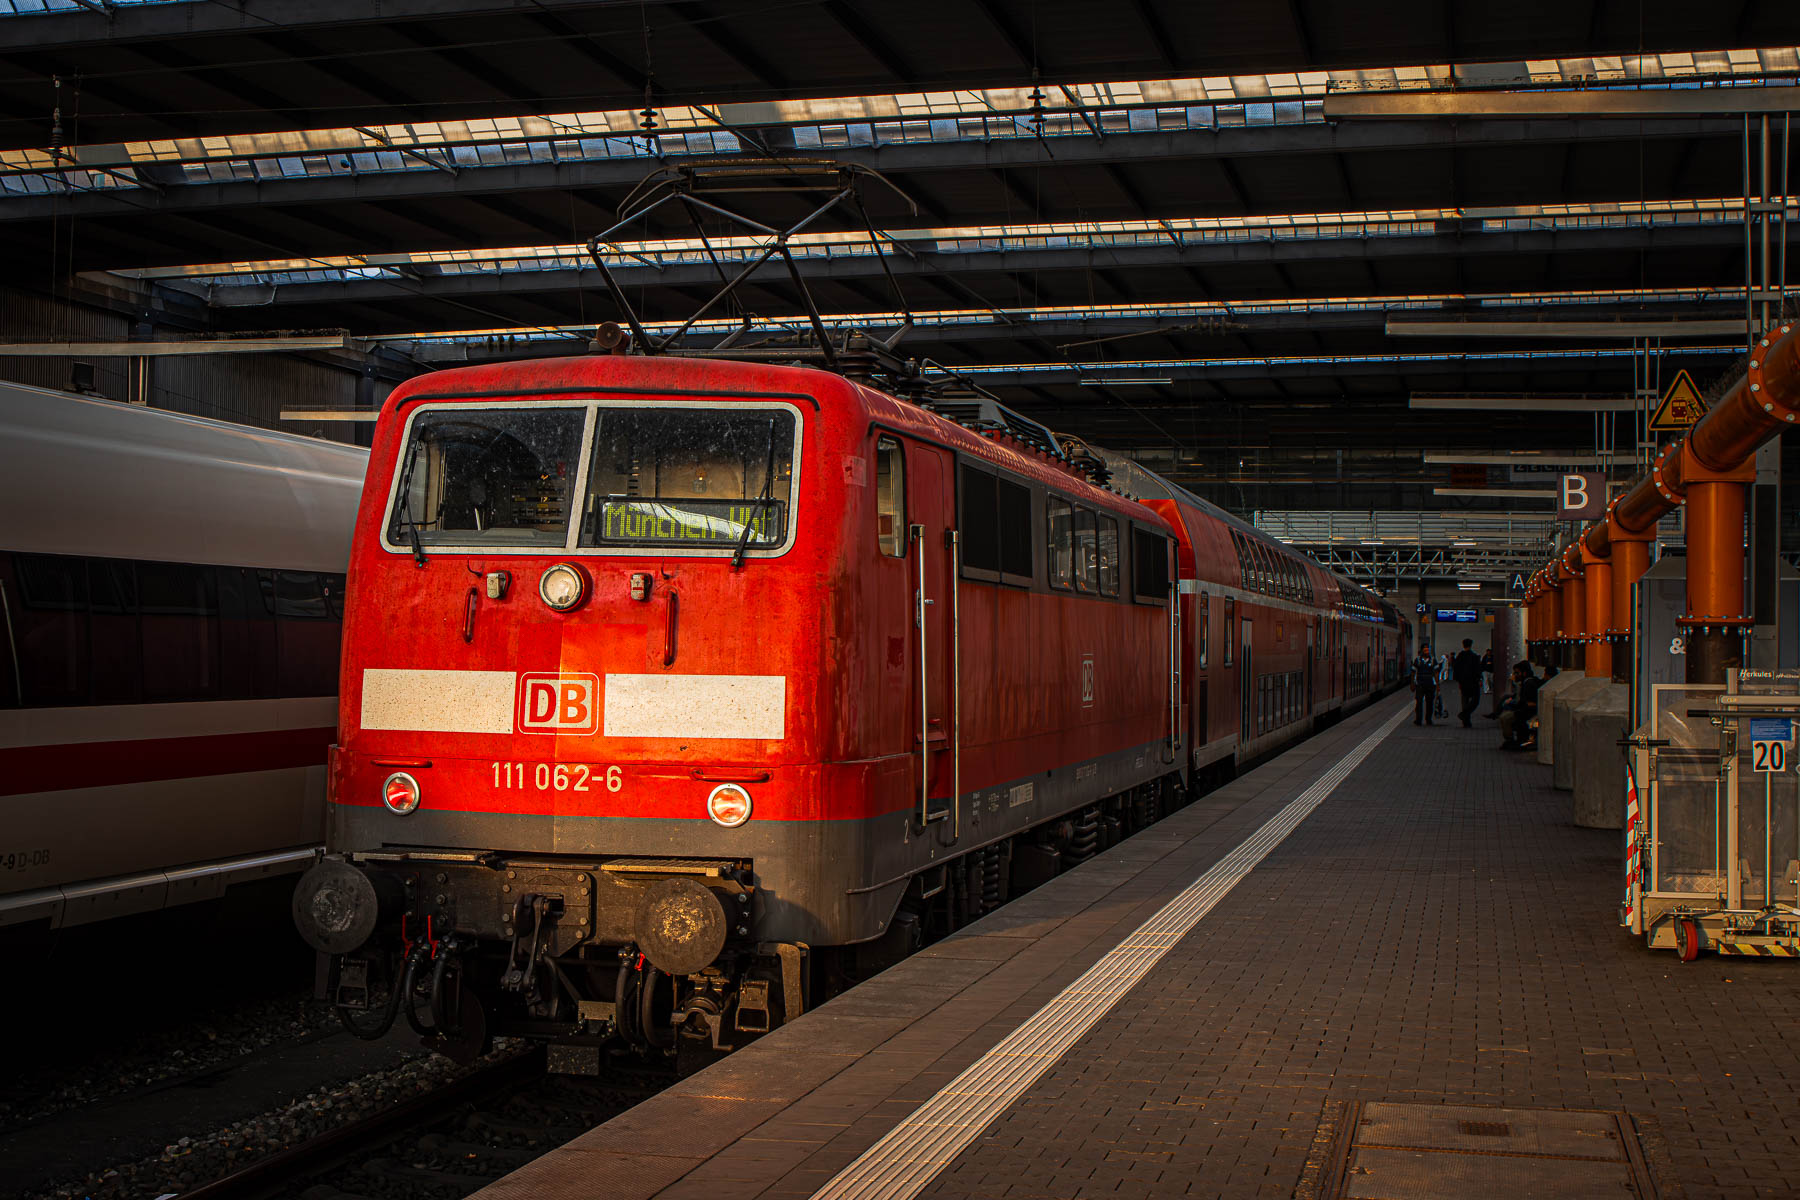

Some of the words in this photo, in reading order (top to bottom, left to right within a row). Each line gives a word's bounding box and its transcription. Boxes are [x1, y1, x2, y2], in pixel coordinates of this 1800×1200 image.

[1563, 475, 1588, 509] B
[606, 504, 716, 539] München
[728, 506, 773, 541] Hbf
[1513, 574, 1525, 590] A
[1416, 603, 1426, 613] 21
[1739, 668, 1773, 681] Herkules
[529, 683, 588, 724] DB
[1755, 742, 1784, 770] 20
[492, 762, 524, 789] 111
[535, 763, 623, 792] 062-6
